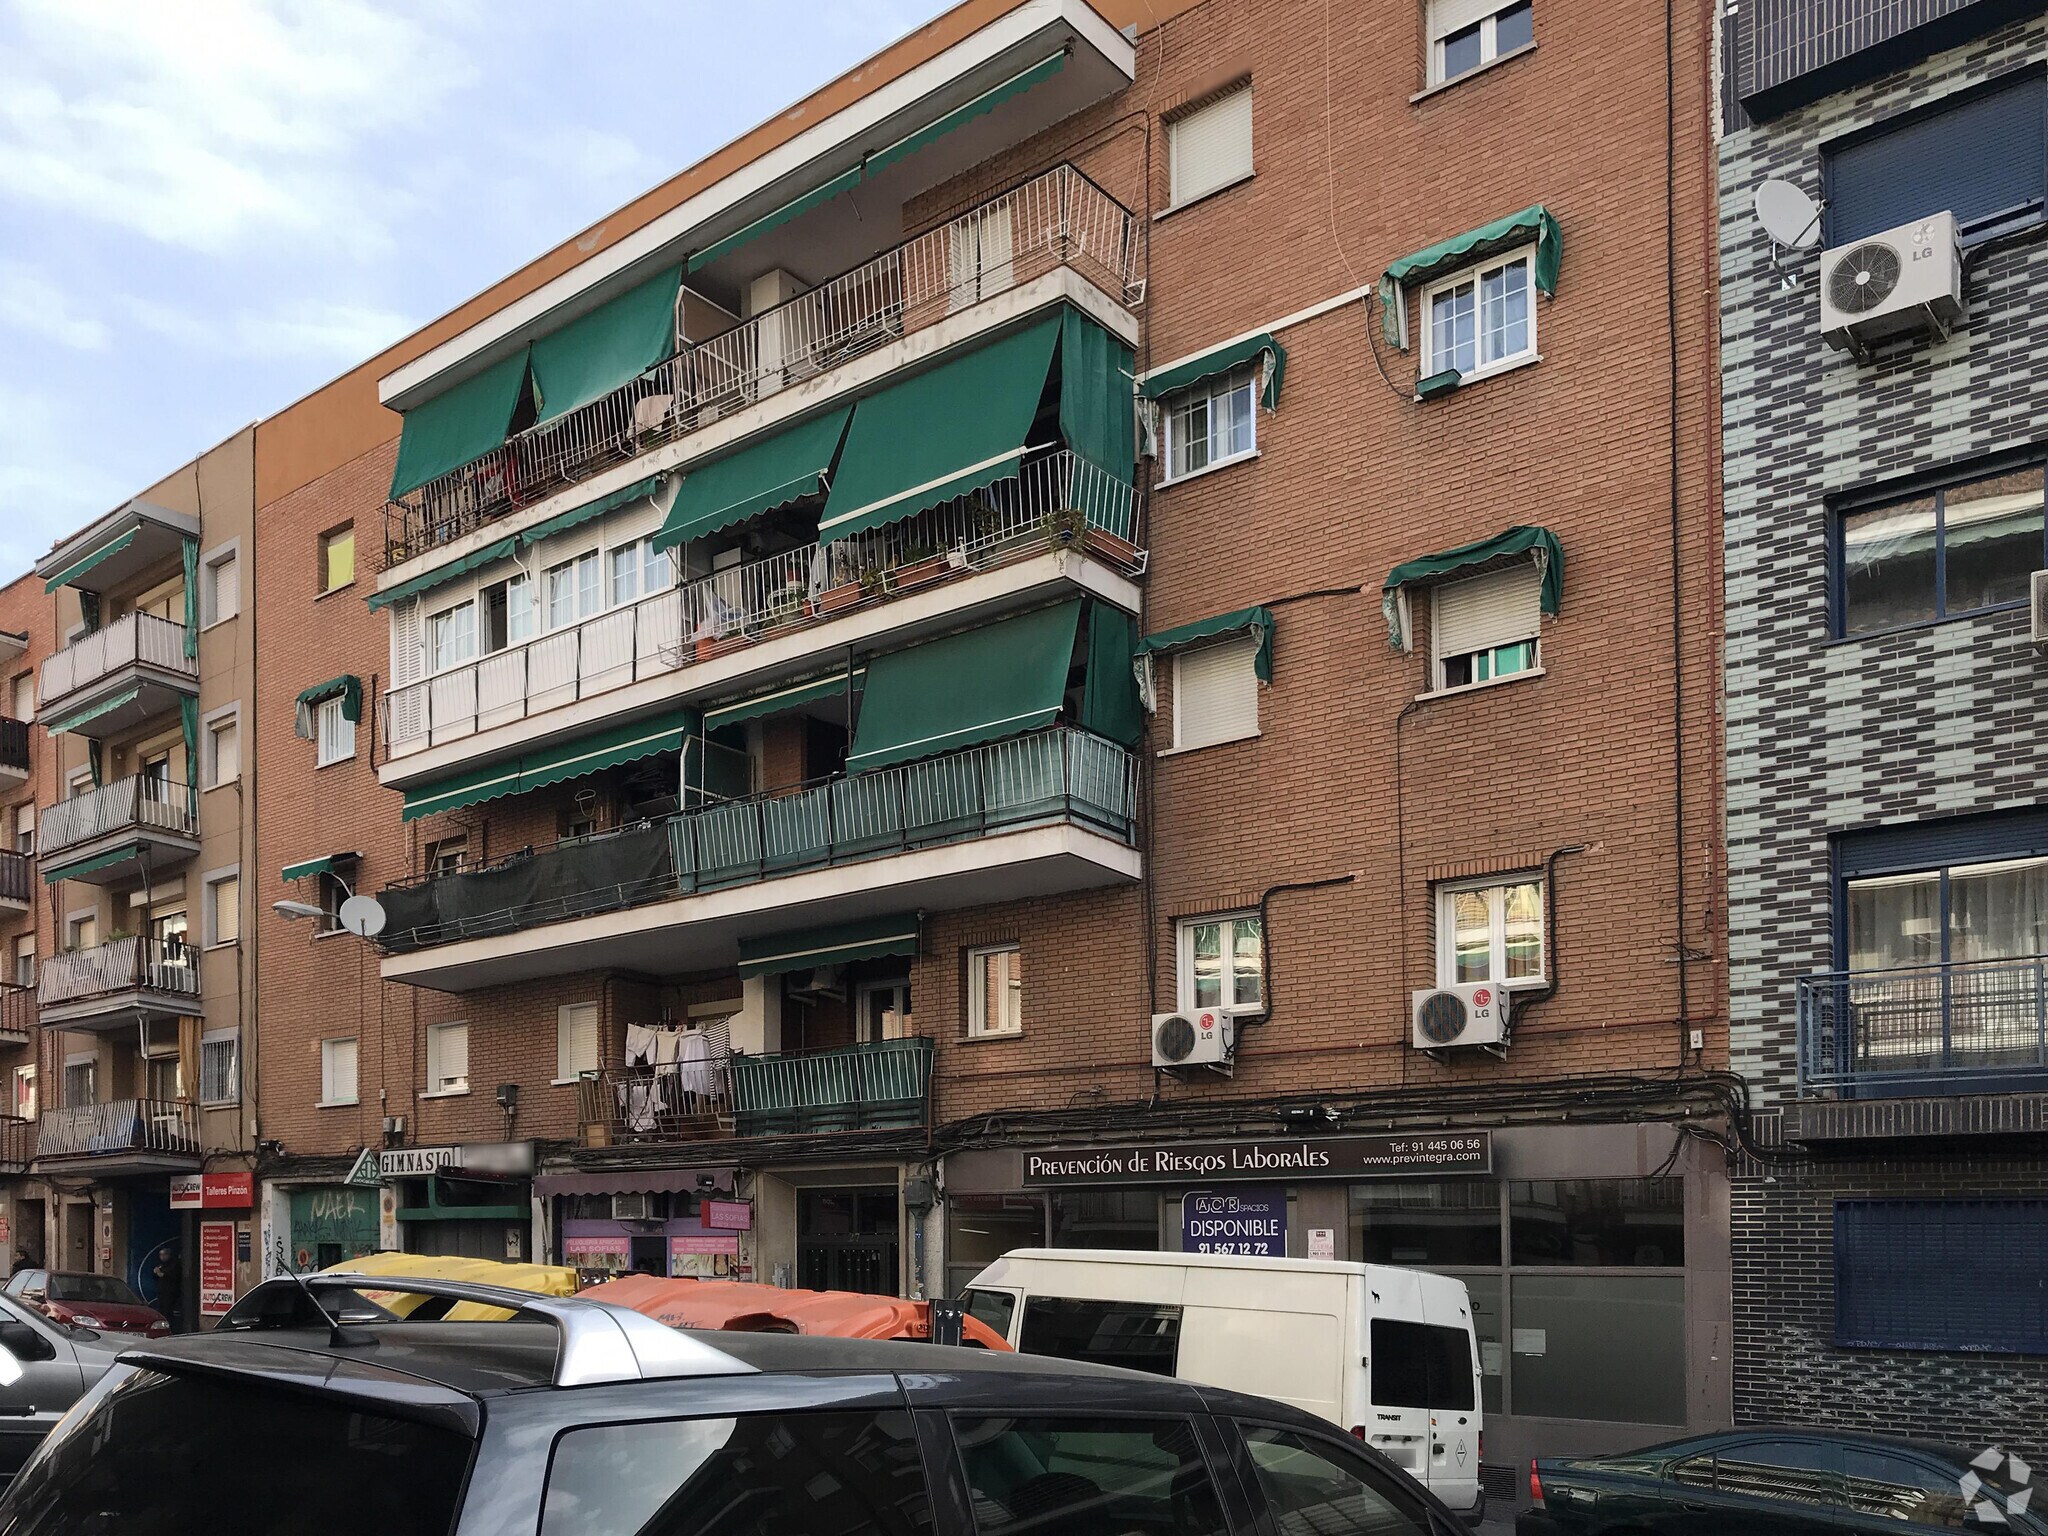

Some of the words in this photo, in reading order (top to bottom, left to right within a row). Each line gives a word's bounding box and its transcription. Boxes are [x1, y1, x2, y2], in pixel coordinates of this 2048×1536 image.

[1912, 246, 1933, 262] LG
[1475, 1009, 1490, 1019] LG
[1201, 1031, 1213, 1040] LG
[1389, 1142, 1409, 1153] Tef:
[1412, 1141, 1424, 1152] 91
[1427, 1140, 1448, 1151] 445
[1450, 1139, 1464, 1150] 06
[1466, 1139, 1481, 1149] 56
[381, 1151, 451, 1173] GIMNASIO
[1363, 1152, 1481, 1165] www.previntegra.com
[206, 1186, 228, 1196] Talleres
[228, 1185, 248, 1195] Pinzón
[711, 1213, 724, 1221] LAS
[724, 1213, 748, 1223] SOFIAS
[1190, 1219, 1279, 1237] DISPONIBLE
[1198, 1242, 1211, 1254] 91
[1214, 1242, 1236, 1255] 567
[1238, 1242, 1251, 1255] 12
[1254, 1242, 1269, 1255] 72
[1376, 1413, 1402, 1421] TRANSIT
